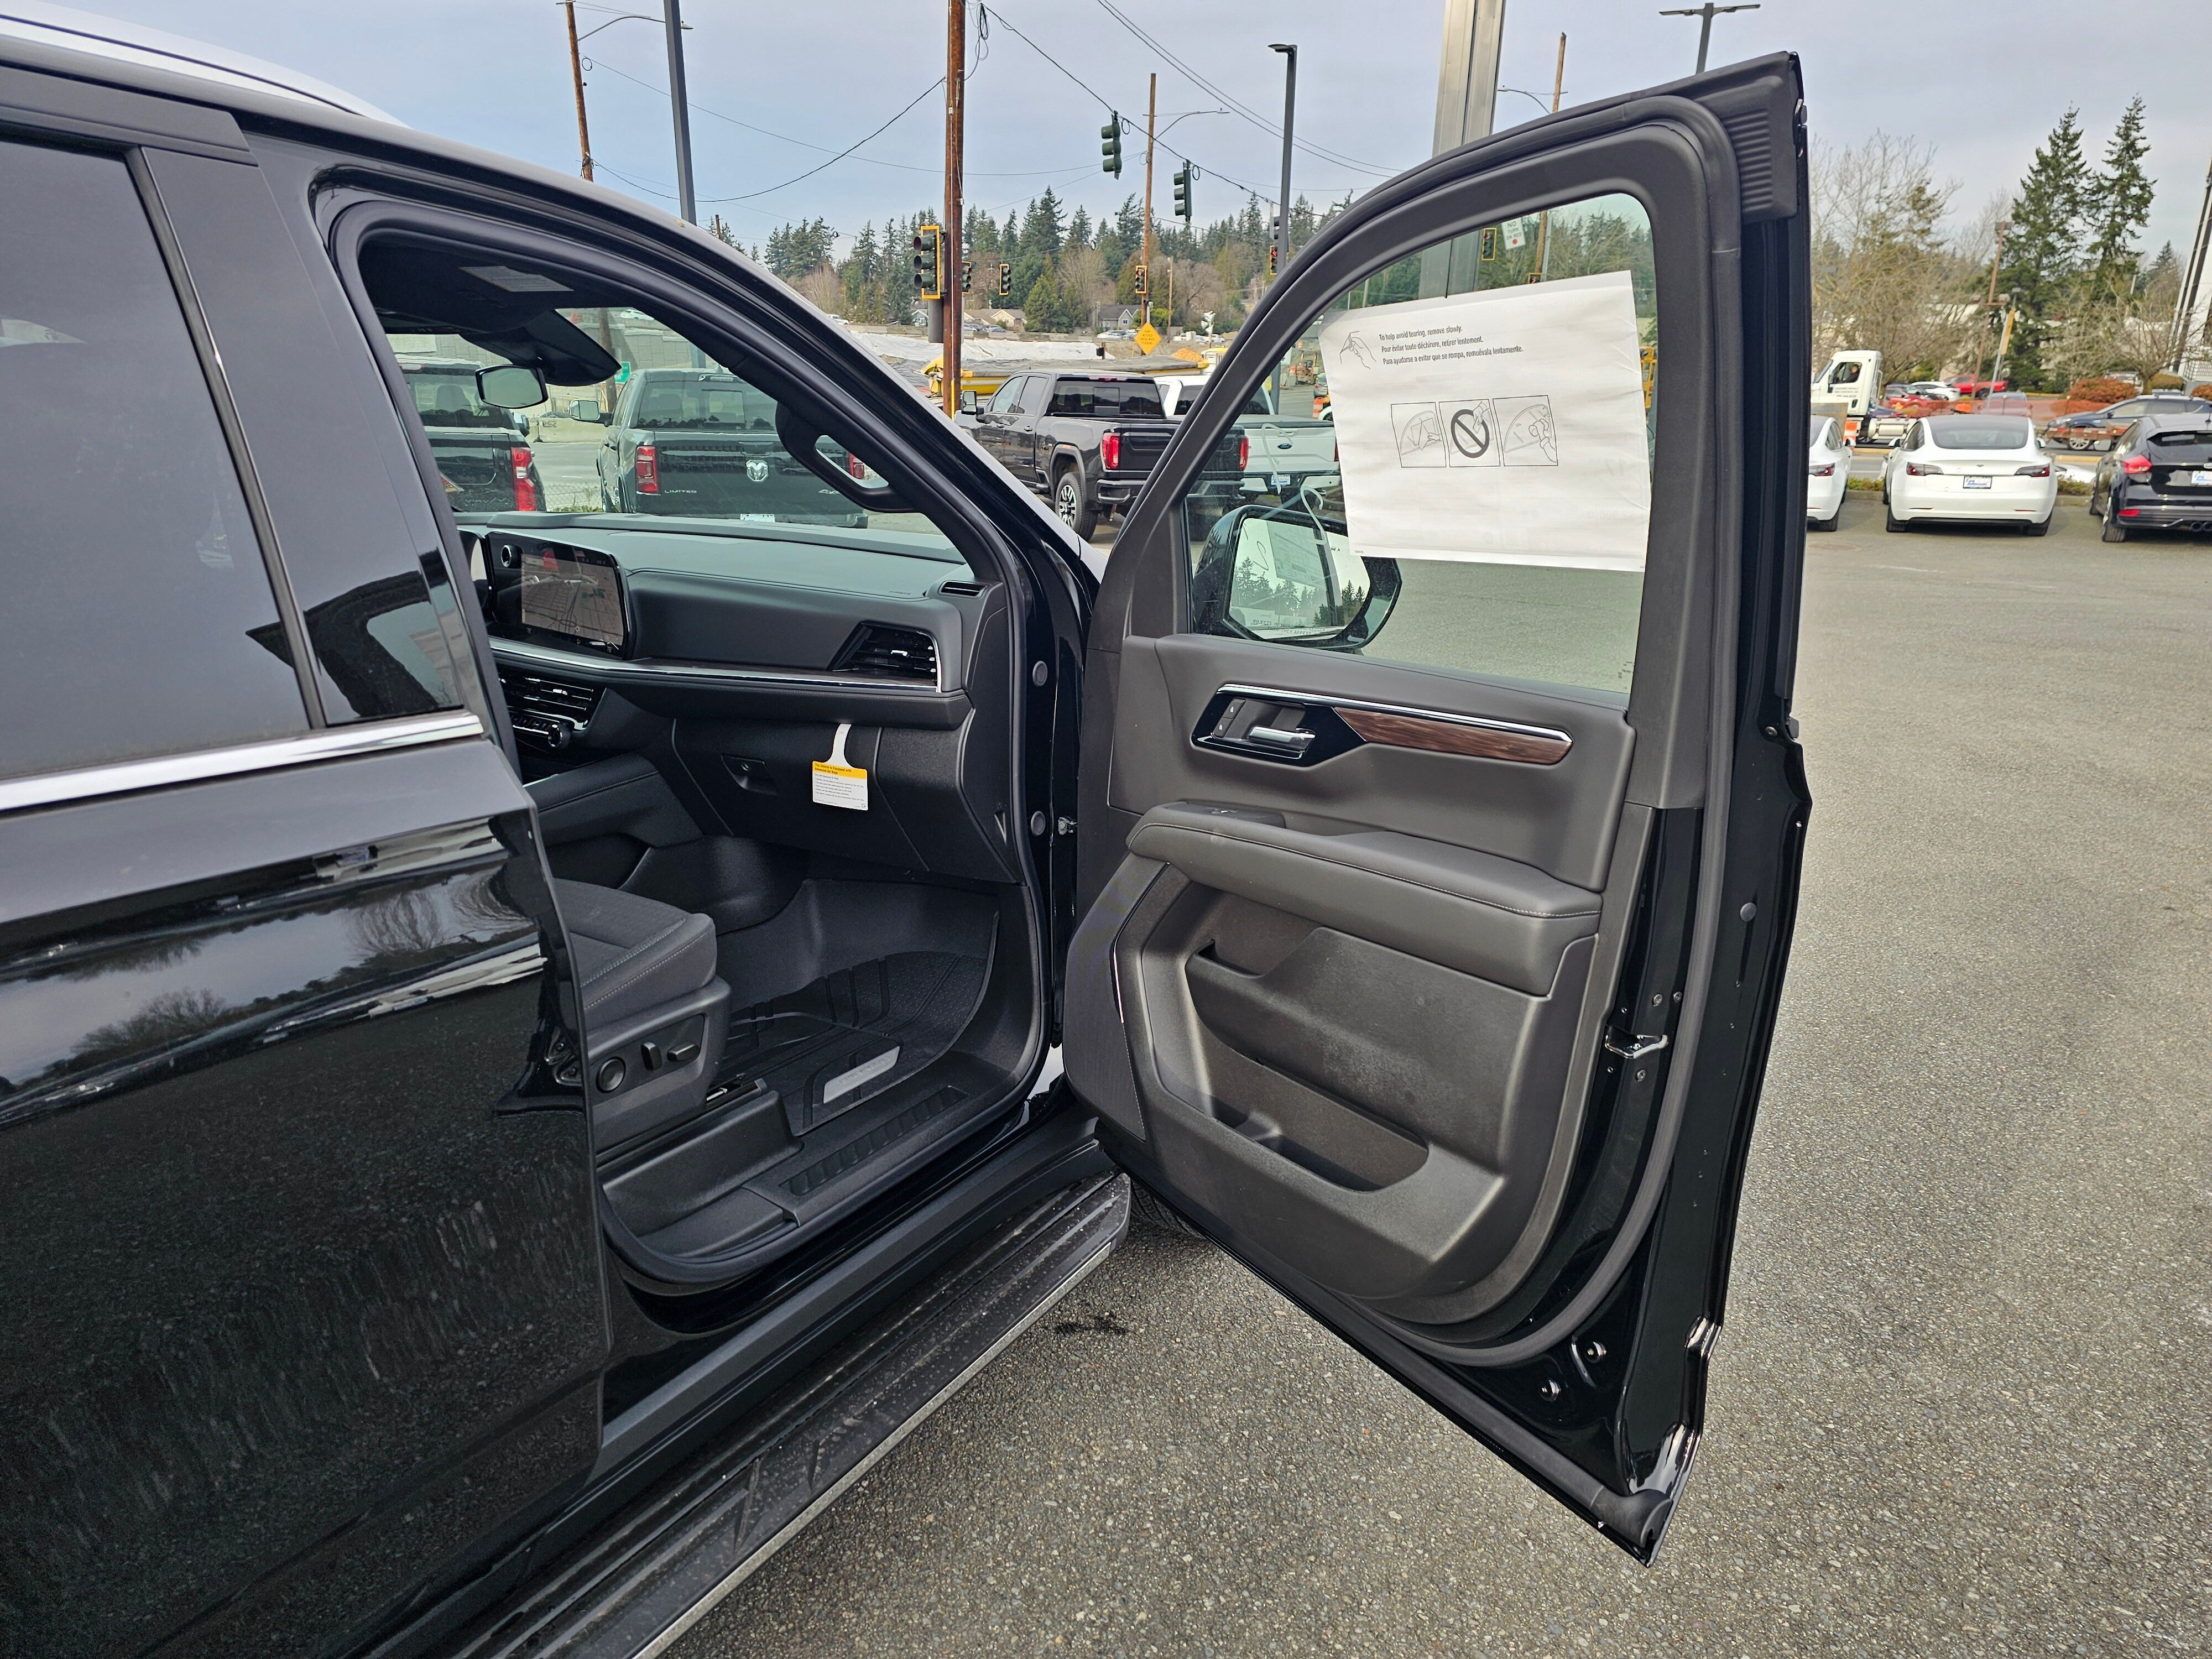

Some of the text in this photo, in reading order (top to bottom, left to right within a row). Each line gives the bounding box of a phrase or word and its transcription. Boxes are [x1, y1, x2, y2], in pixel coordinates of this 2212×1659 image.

[1446, 325, 1463, 333] slowly.
[1457, 336, 1484, 345] lentement.
[1394, 357, 1413, 365] ayudarse
[1466, 348, 1492, 357] remuévala
[1493, 345, 1524, 354] lentamente.
